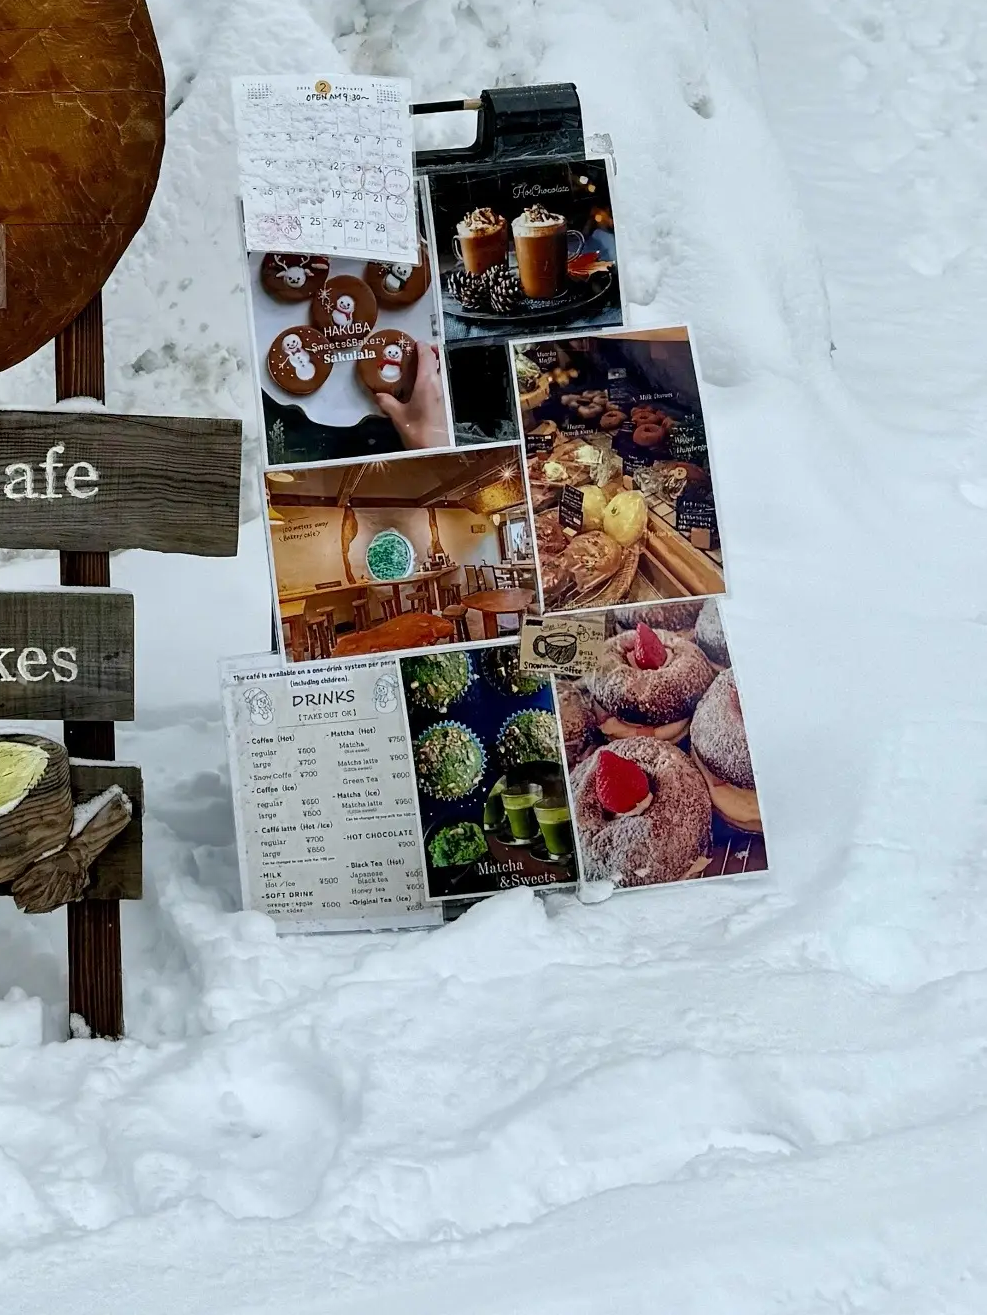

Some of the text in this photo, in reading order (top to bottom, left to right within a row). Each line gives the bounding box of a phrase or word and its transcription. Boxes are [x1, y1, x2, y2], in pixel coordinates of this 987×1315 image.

[305, 93, 327, 102] OPEN
[353, 135, 360, 143] 6
[376, 136, 381, 145] 7
[396, 139, 402, 148] 8
[332, 189, 341, 199] 19
[352, 191, 363, 201] 20
[373, 193, 383, 203] 21
[309, 216, 321, 226] 25
[332, 218, 343, 228] 26
[353, 220, 364, 230] 27
[375, 223, 386, 233] 28
[323, 322, 371, 338] HAKUBA
[311, 336, 387, 352] Sweets&Bakery
[323, 348, 377, 364] Sakulala
[232, 674, 245, 682] The
[246, 671, 260, 680] café
[262, 671, 267, 679] is
[268, 669, 296, 678] available
[312, 664, 343, 674] one-drink
[344, 662, 367, 672] system
[368, 661, 379, 669] per
[290, 678, 320, 688] (including
[292, 689, 356, 707] DRINKS
[323, 711, 339, 719] OUT
[358, 727, 376, 735] (Hot)
[277, 734, 295, 743] (Hot)
[338, 741, 365, 749] Matcha
[251, 749, 277, 758] regular
[298, 758, 317, 767] ¥750
[337, 759, 362, 767] Matcha
[299, 770, 318, 778] ¥700
[342, 777, 365, 785] Green
[282, 783, 298, 792] (Ice)
[336, 788, 381, 799] Matcha (Ice)
[257, 800, 283, 809] regular
[341, 801, 366, 809] Matcha
[365, 829, 414, 839] CHOCOLATE
[260, 835, 324, 847] regular ¥700
[262, 851, 281, 859] large
[350, 861, 369, 869] Black
[477, 858, 524, 876] Matcha
[499, 871, 557, 889] &Sweets
[289, 890, 314, 898] DRINK
